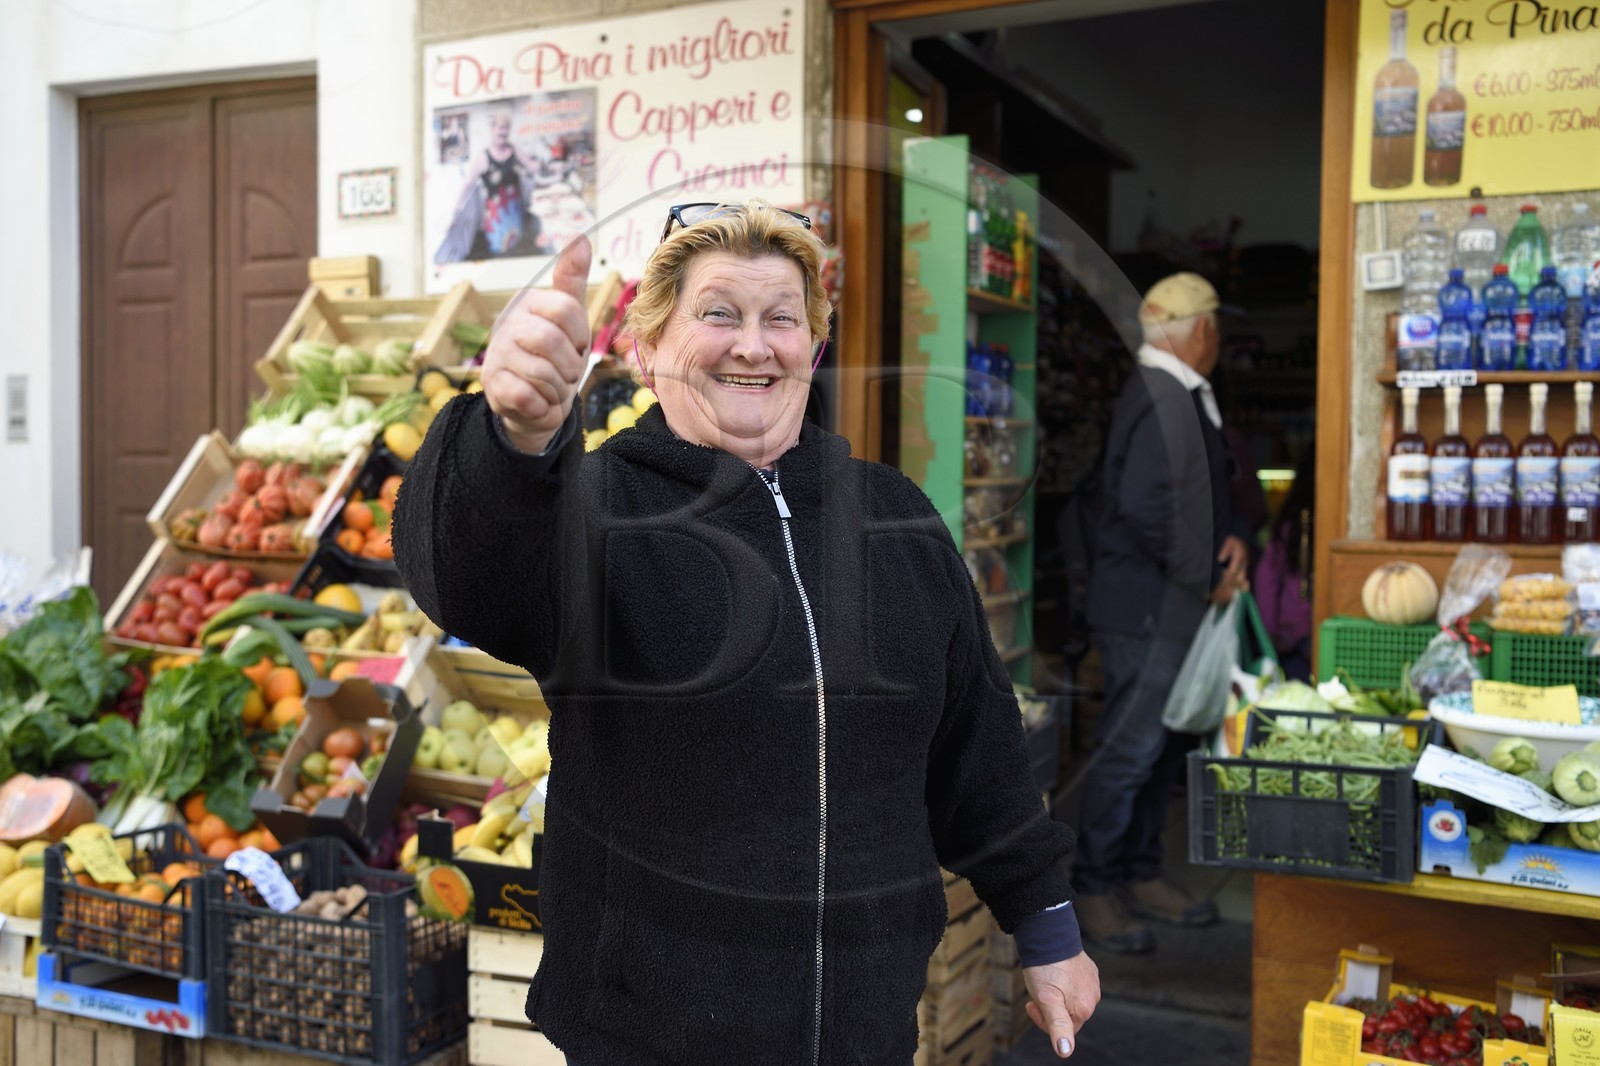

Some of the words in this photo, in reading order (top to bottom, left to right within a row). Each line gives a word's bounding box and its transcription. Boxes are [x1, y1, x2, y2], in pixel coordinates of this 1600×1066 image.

[1423, 6, 1473, 46] da
[1486, 0, 1599, 39] Pina
[434, 54, 504, 97] Da
[513, 42, 612, 88] Pina
[626, 43, 639, 75] i
[647, 16, 795, 80] migliori
[607, 89, 761, 145] Capperi
[770, 90, 792, 121] e
[350, 181, 386, 208] 168
[609, 218, 644, 260] di
